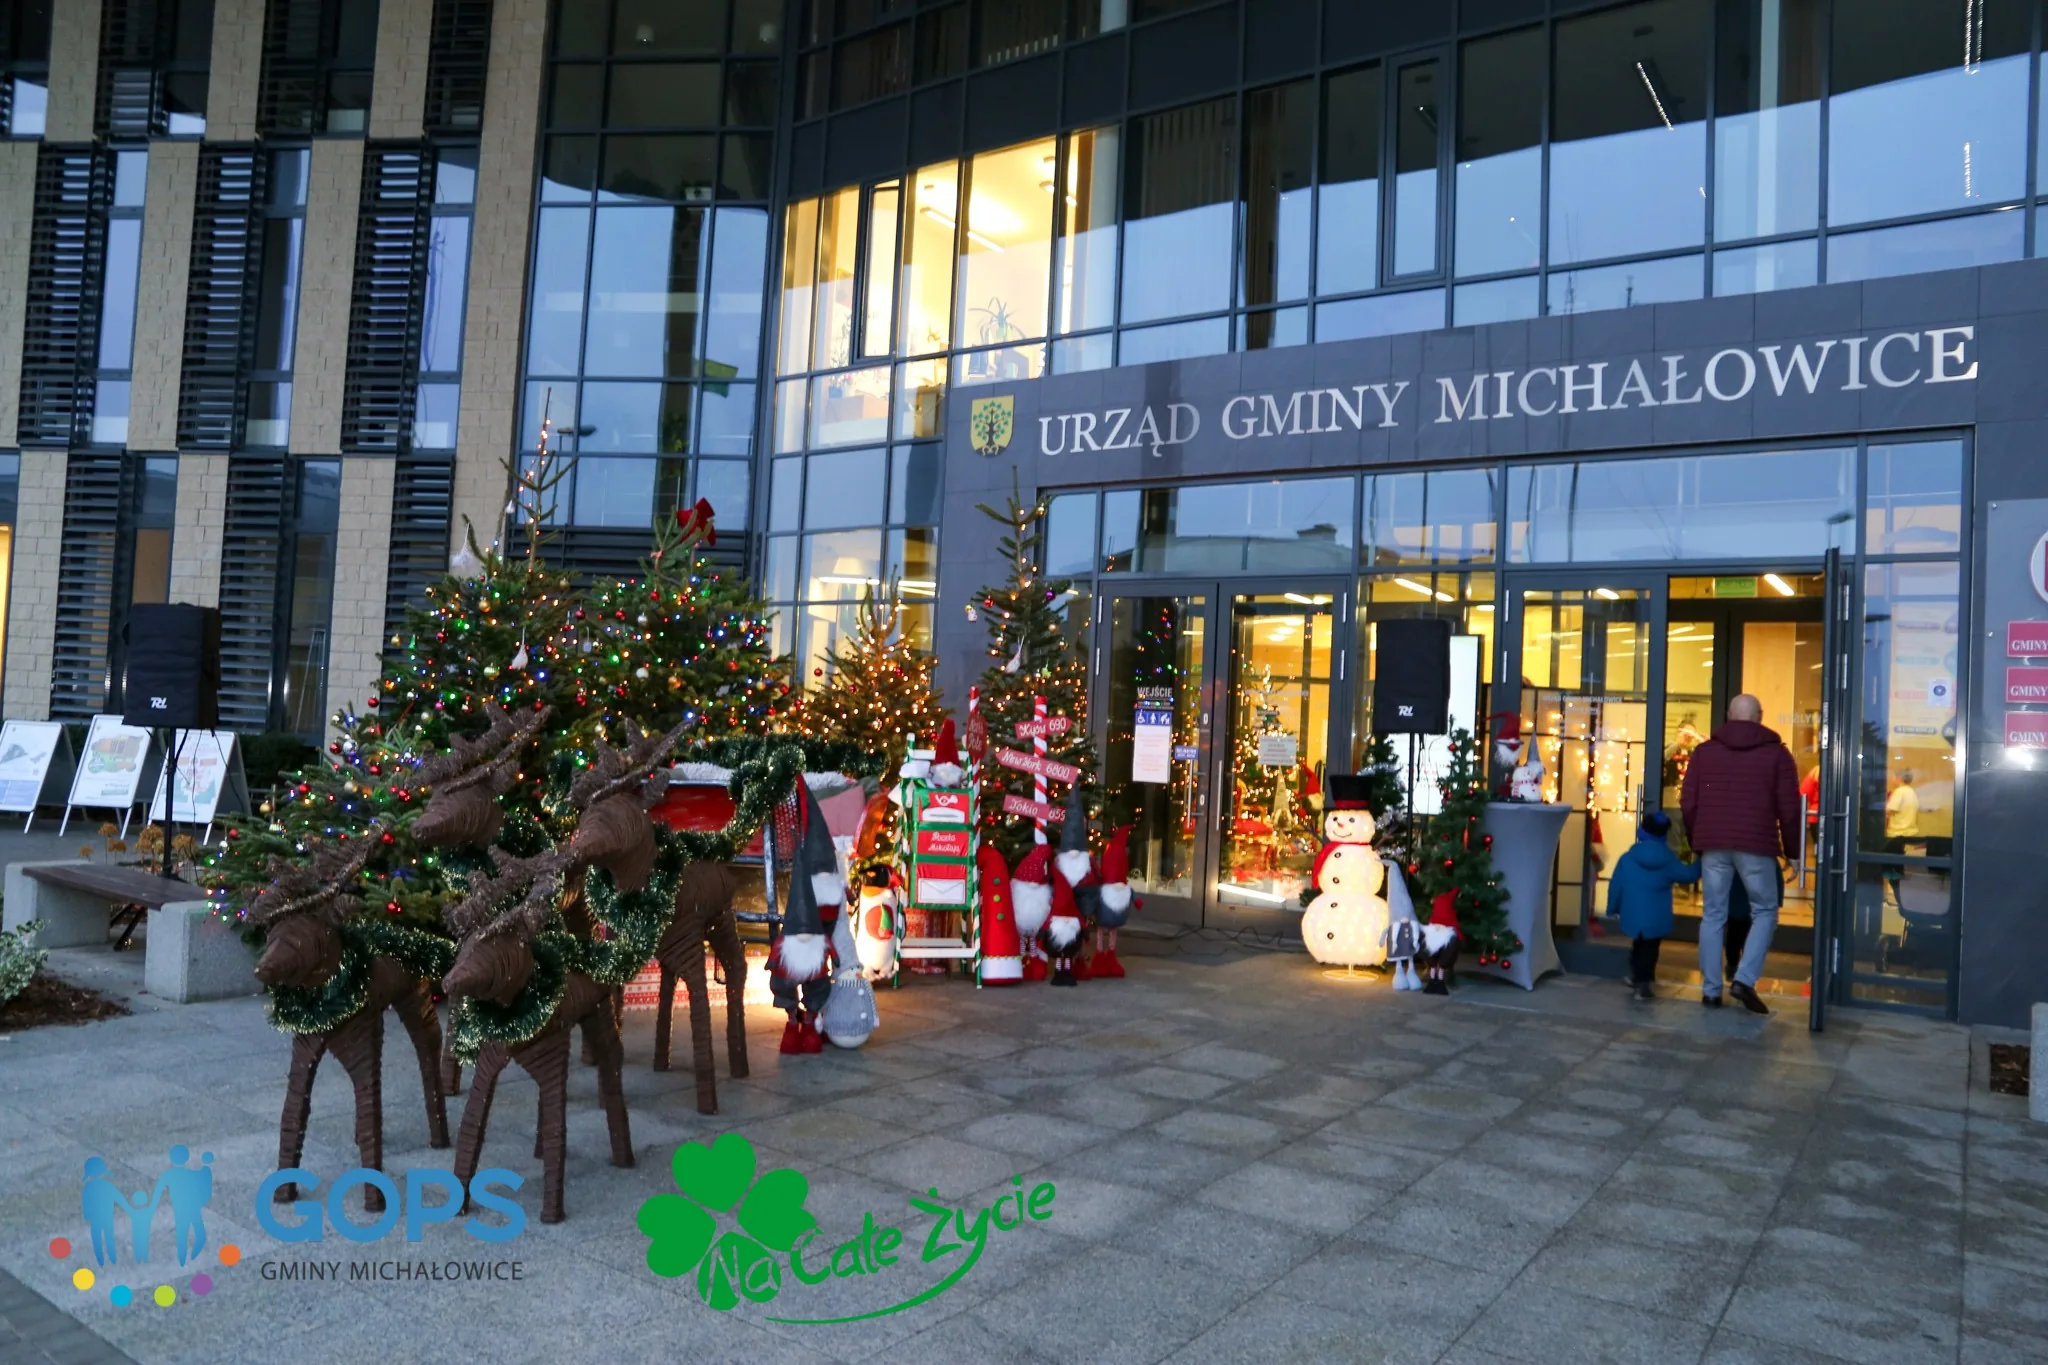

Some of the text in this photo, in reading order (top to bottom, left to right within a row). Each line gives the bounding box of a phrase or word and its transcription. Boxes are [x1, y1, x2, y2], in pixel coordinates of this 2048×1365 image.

[1038, 325, 1979, 458] URZĄD GMINY MICHAŁOWICE
[2011, 639, 2048, 651] GMINY
[1137, 685, 1173, 698] WEJŚCIE
[2010, 685, 2048, 697] GMINY
[1049, 717, 1067, 731] 690
[2009, 731, 2047, 743] GMINY
[1046, 763, 1070, 779] 6800
[1009, 798, 1038, 815] Tokio
